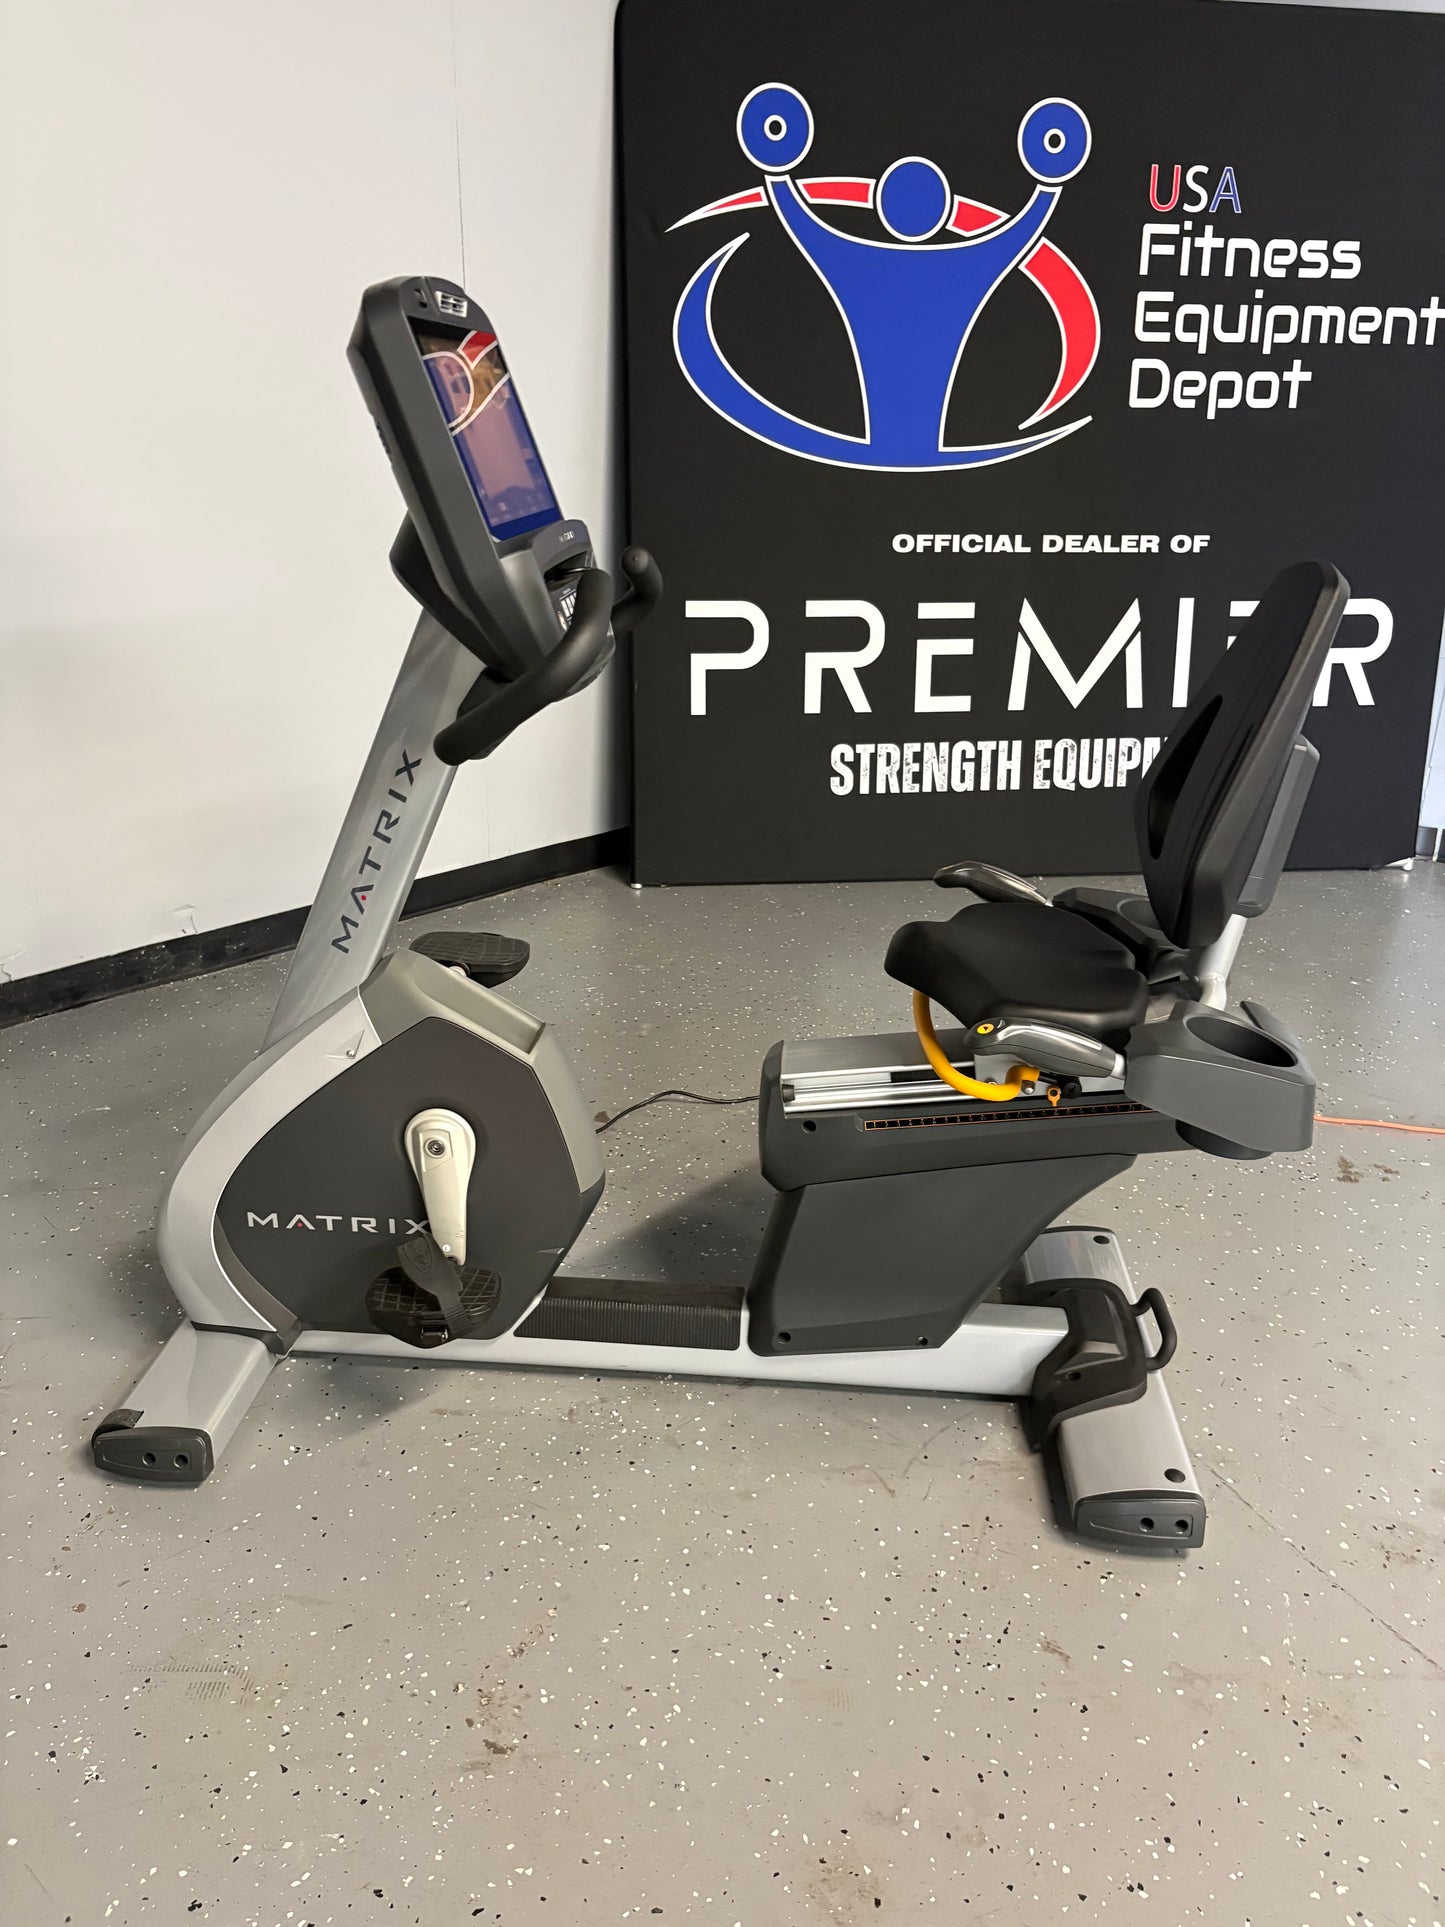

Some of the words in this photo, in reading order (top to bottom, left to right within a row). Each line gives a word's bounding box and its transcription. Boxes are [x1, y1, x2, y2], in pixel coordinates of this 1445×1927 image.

[1149, 164, 1242, 213] USA
[1139, 220, 1362, 280] Fitness
[1134, 289, 1445, 355] Equipment
[1128, 358, 1313, 420] Depot
[891, 533, 1032, 554] OFFICIAL
[1041, 534, 1161, 554] DEALER
[1169, 534, 1211, 554] OF
[829, 739, 1023, 796] STRENGTH
[330, 748, 423, 955] MATRIX
[246, 1211, 430, 1235] MATRIX
